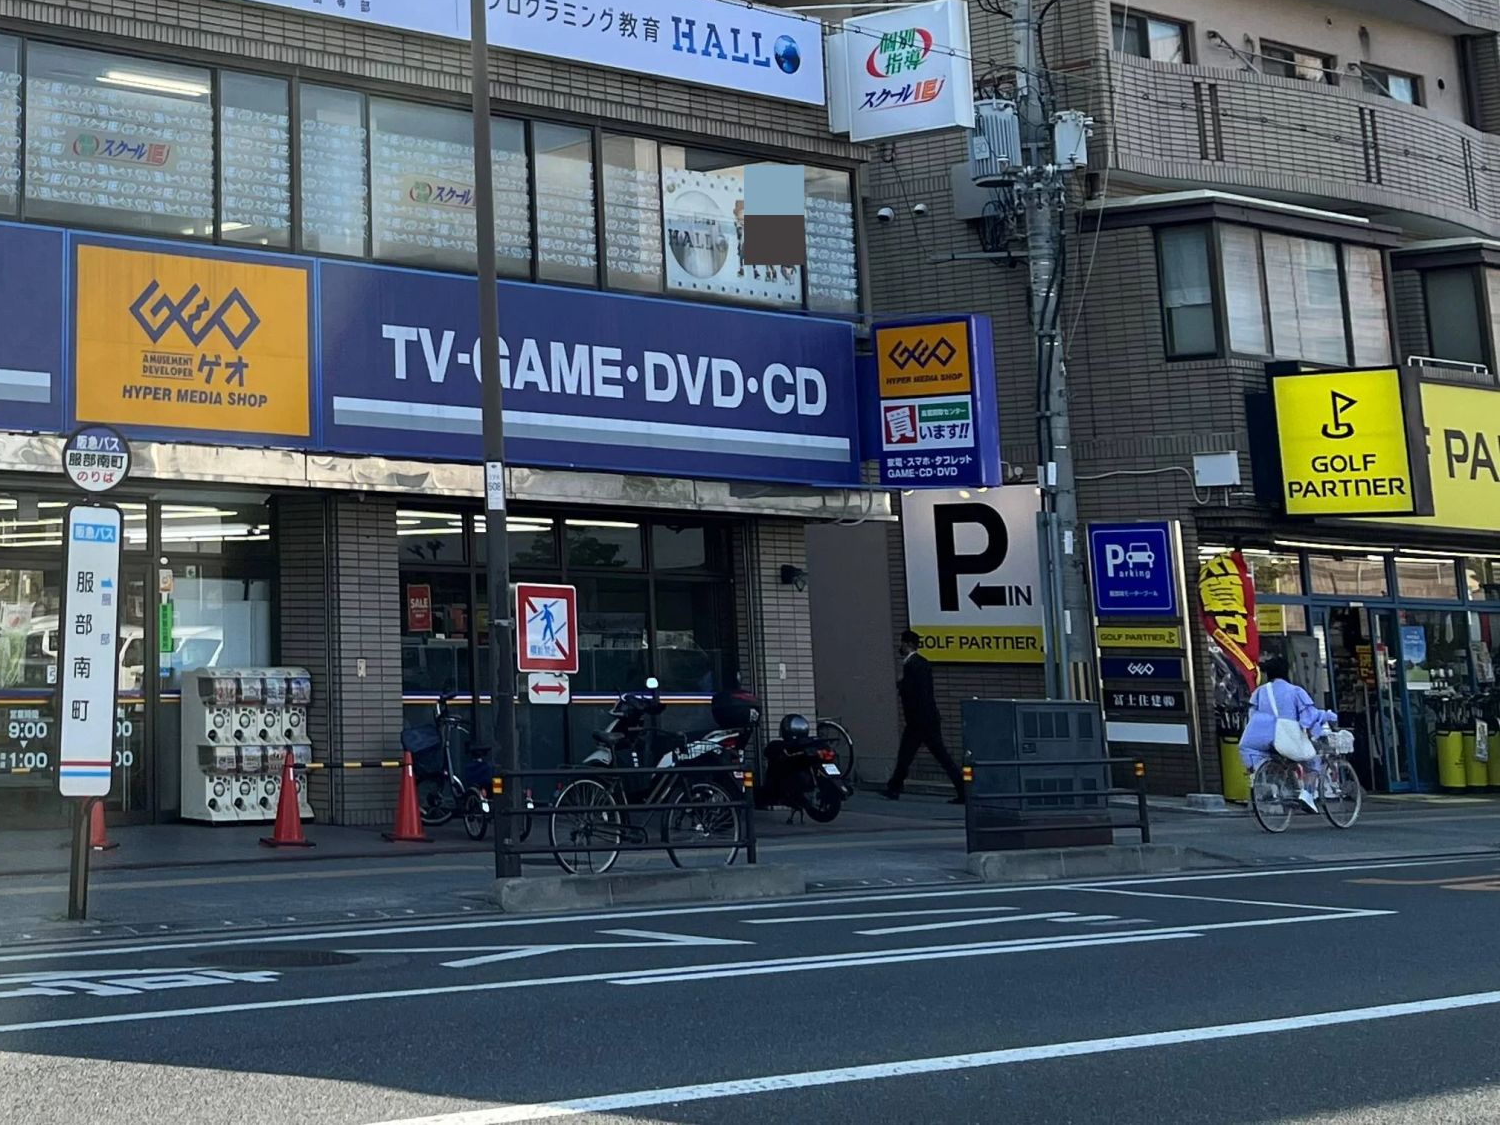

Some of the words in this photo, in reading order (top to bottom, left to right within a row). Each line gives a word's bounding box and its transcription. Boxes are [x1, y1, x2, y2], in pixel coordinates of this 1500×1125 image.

[880, 28, 916, 54] 個別
[885, 49, 922, 75] 指導
[129, 279, 261, 350] GEO
[142, 353, 193, 366] AMUSEMENT
[889, 337, 957, 370] GEO
[142, 365, 193, 378] DEVELOPER
[198, 353, 249, 387] ゲオ
[122, 385, 171, 401] HYPER
[176, 389, 222, 405] MEDIA
[227, 392, 268, 408] SHOP
[76, 435, 120, 451] 阪急バス
[68, 452, 124, 469] 服部南町
[1311, 454, 1376, 472] GOLF
[1444, 429, 1500, 483] PA
[77, 471, 115, 483] のりば
[1289, 477, 1406, 498] PARTNER
[74, 525, 115, 541] 阪急バス
[933, 502, 1008, 611] P
[410, 598, 428, 608] SALE
[1008, 585, 1032, 606] IN
[959, 636, 1037, 649] PARTNER
[1101, 633, 1123, 641] GOLF
[71, 571, 94, 721] 服部南町
[1127, 663, 1154, 675] GEO
[8, 722, 47, 738] 9:00
[9, 752, 48, 768] 1:00
